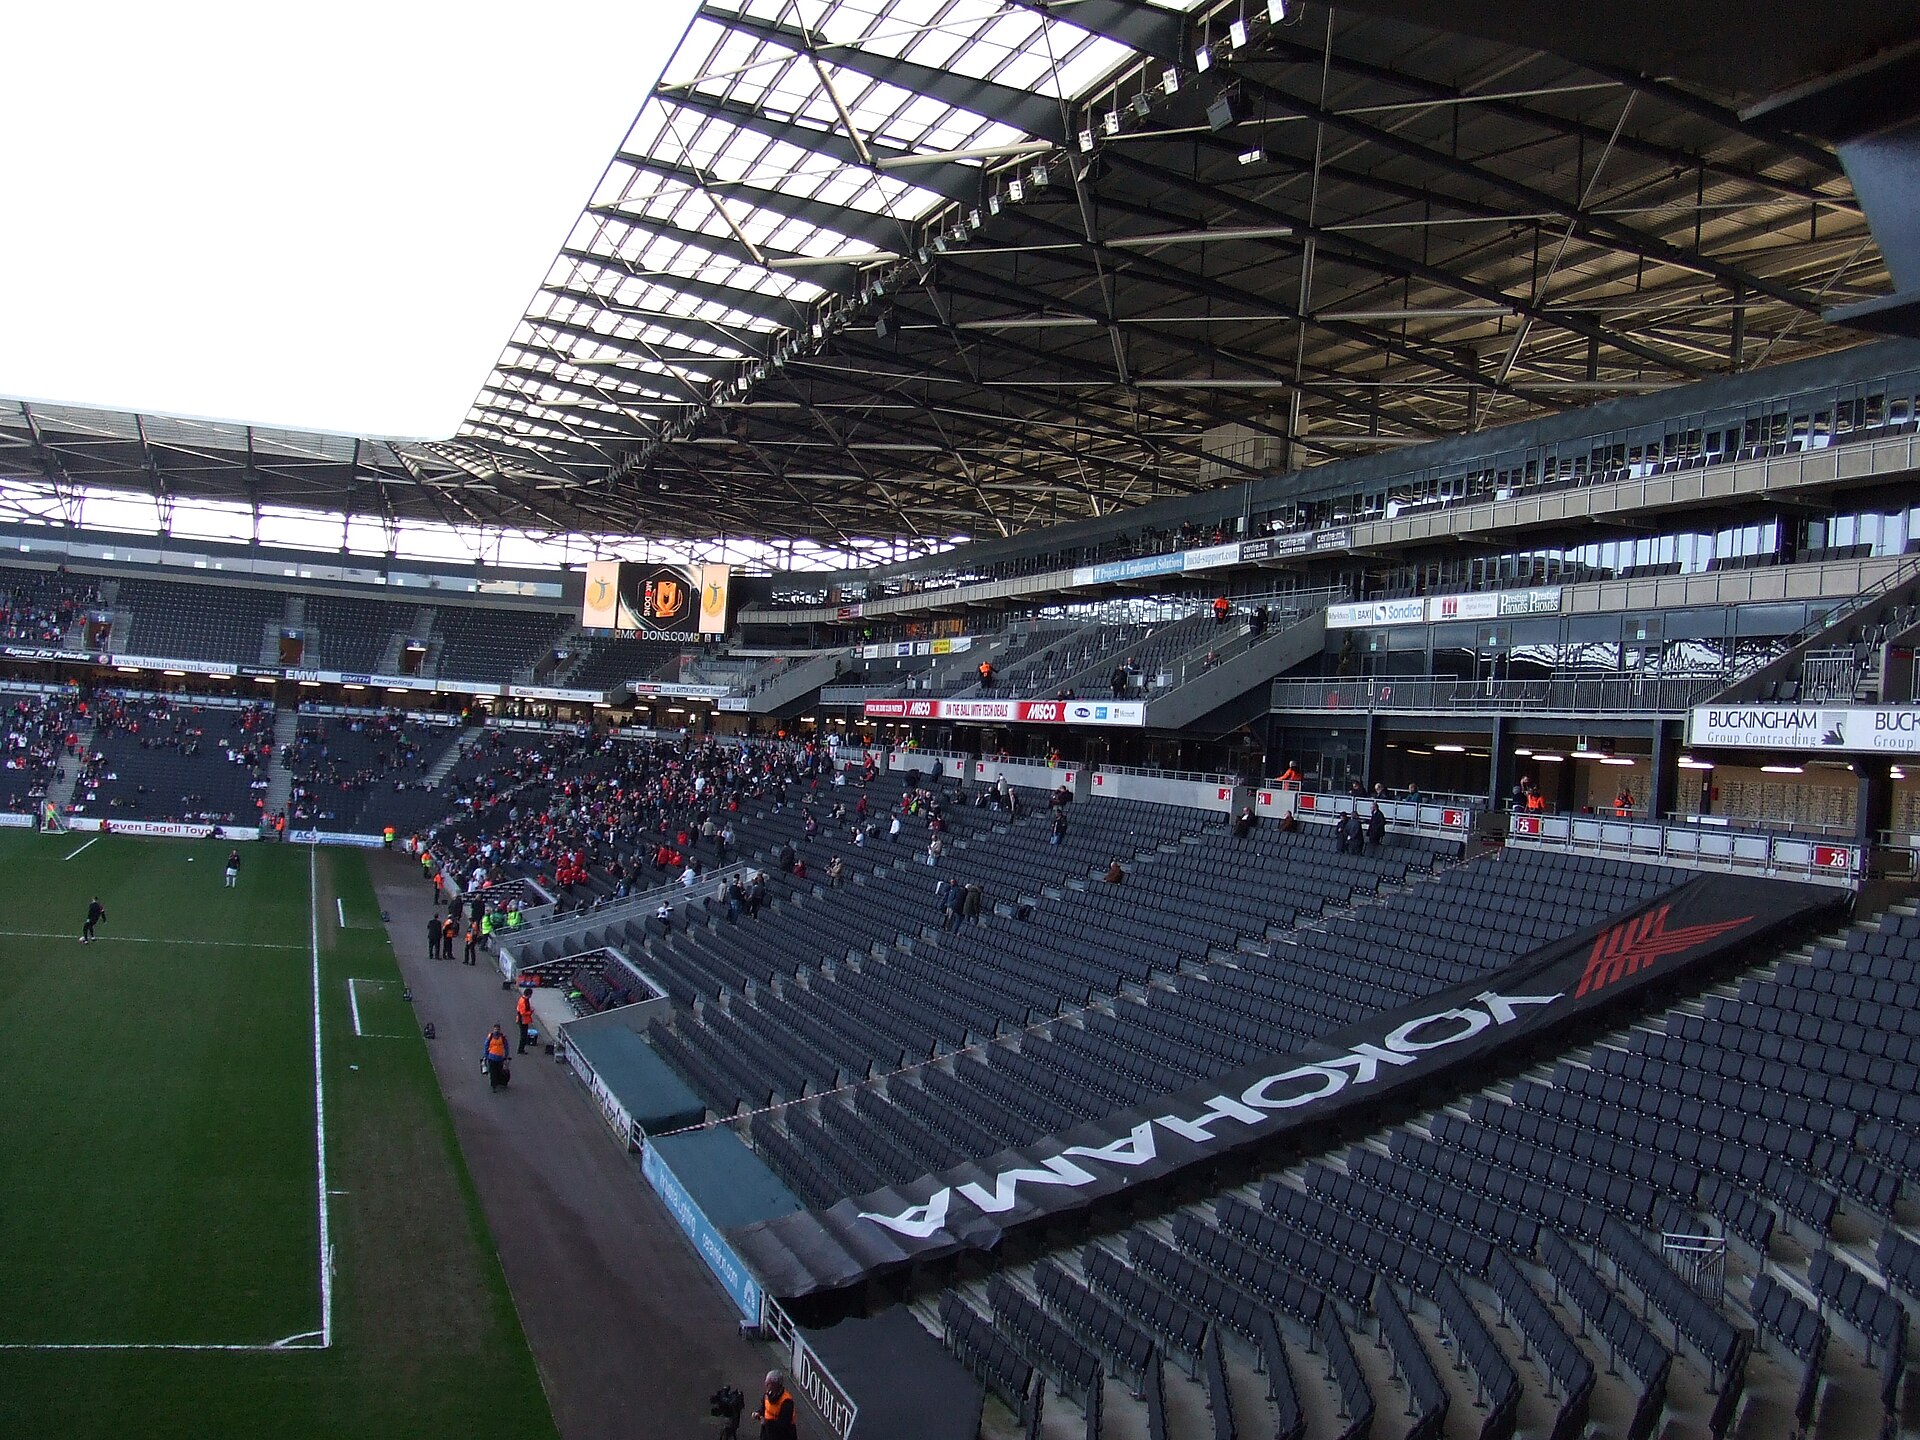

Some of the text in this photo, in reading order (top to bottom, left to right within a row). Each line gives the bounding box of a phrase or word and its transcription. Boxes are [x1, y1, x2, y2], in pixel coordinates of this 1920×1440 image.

[1157, 557, 1183, 569] Solutions
[1357, 609, 1372, 620] BAXI
[1388, 604, 1422, 620] Sondico
[642, 630, 693, 642] DONS.COM
[114, 659, 235, 674] www.businessmk.co.uk
[285, 670, 318, 681] EMW
[373, 678, 414, 687] recycling
[909, 702, 930, 716] MISCO
[994, 704, 1008, 717] DEALS
[1026, 703, 1056, 720] MISCO
[1709, 711, 1817, 729] BUCKINGHAM
[1707, 732, 1816, 747] Group Contracting
[1874, 735, 1913, 751] Group
[1452, 815, 1461, 825] 25
[1519, 822, 1529, 832] 25
[108, 822, 212, 836] teven Eagell Toyo
[1830, 853, 1844, 866] 26
[856, 990, 1566, 1239] YOKOHAMA
[801, 1354, 852, 1440] DOUBLET
